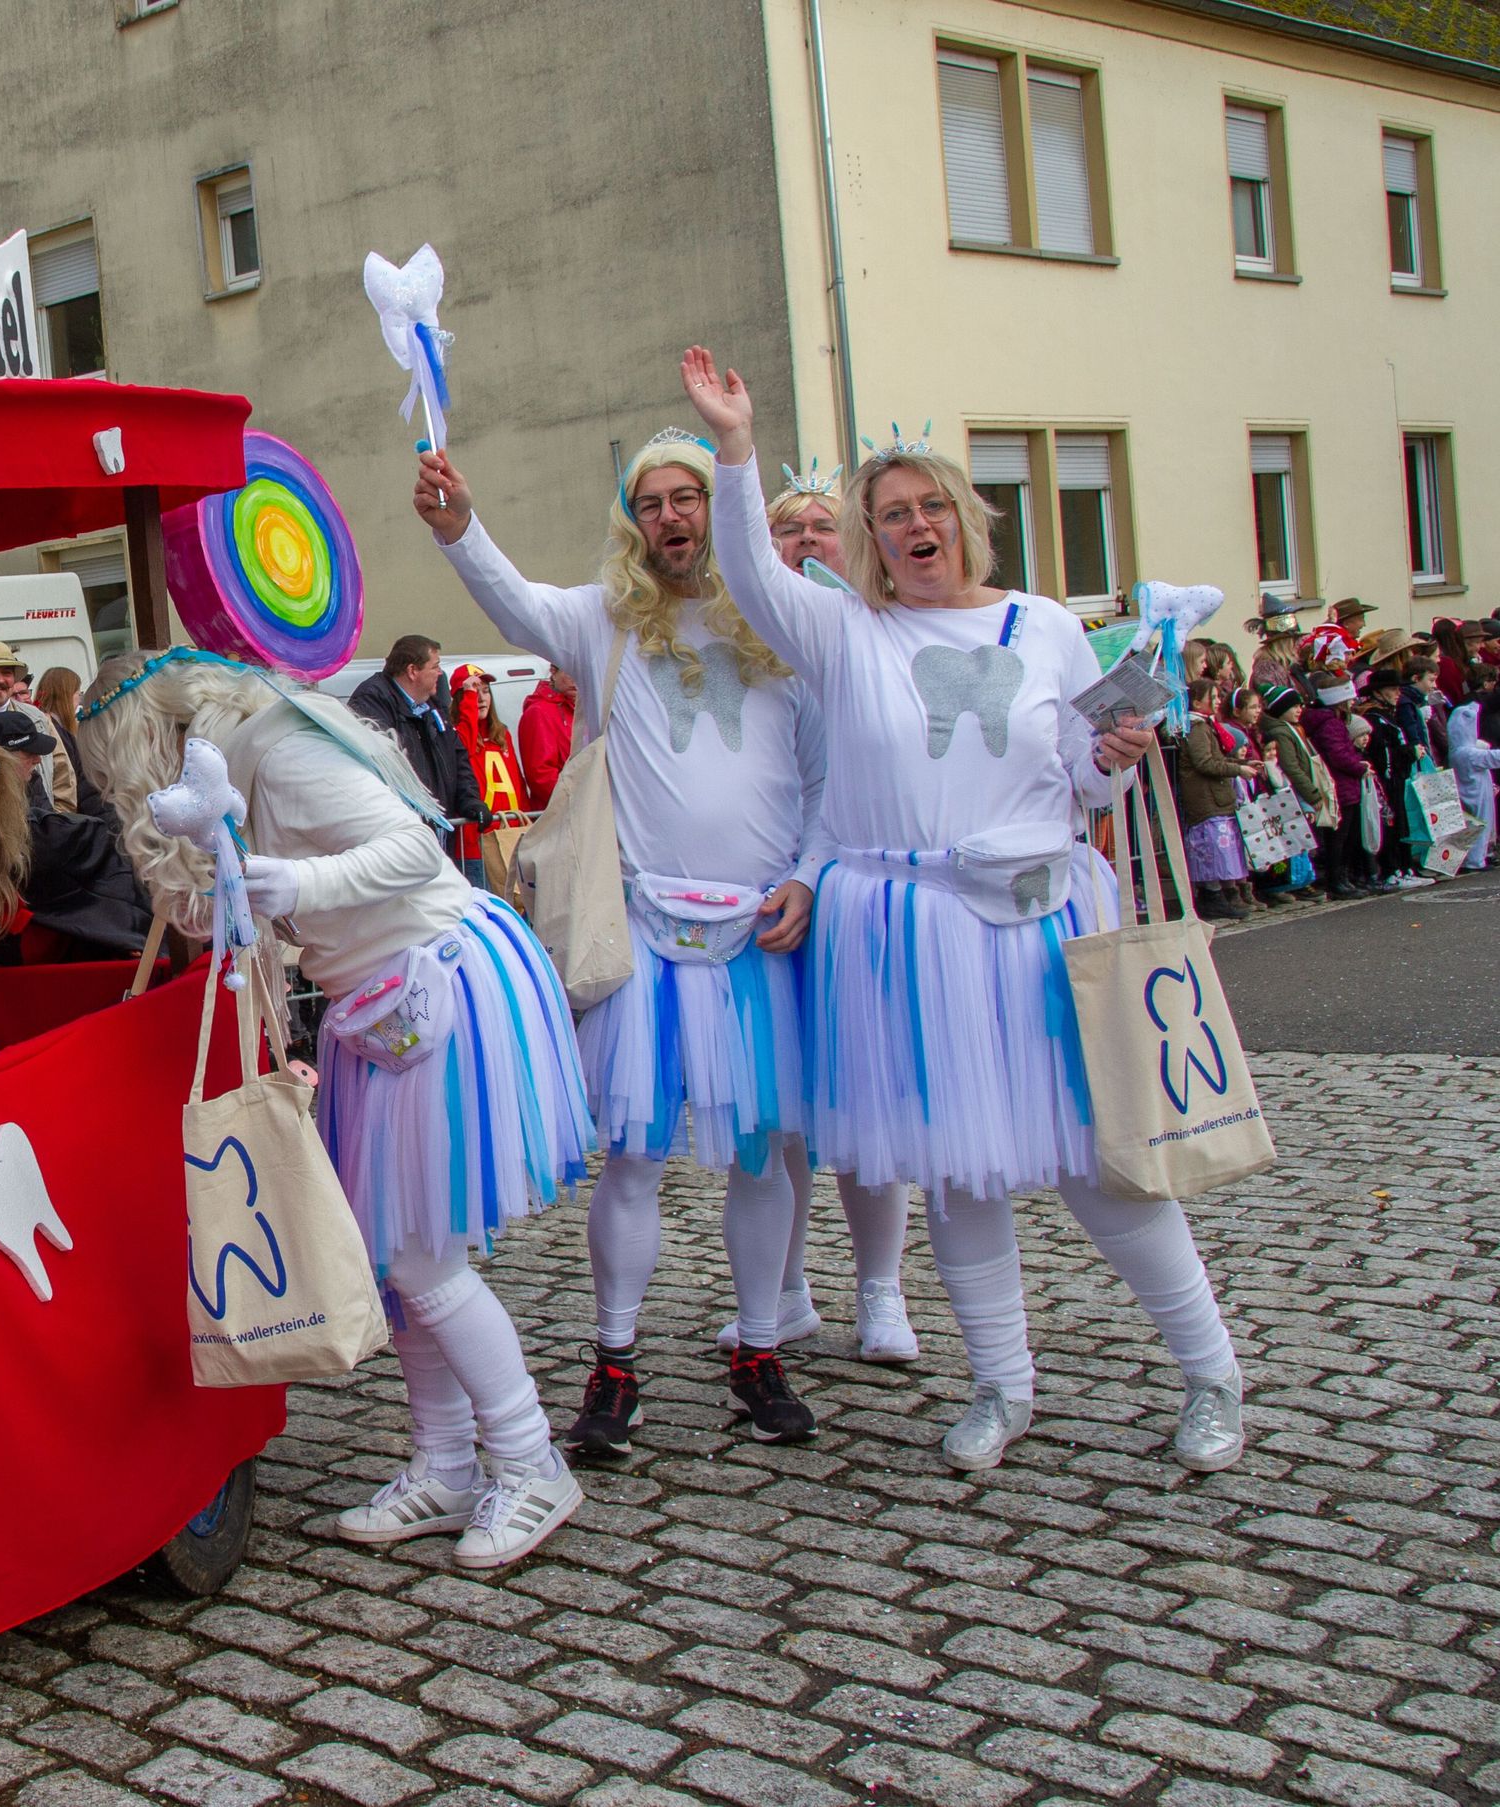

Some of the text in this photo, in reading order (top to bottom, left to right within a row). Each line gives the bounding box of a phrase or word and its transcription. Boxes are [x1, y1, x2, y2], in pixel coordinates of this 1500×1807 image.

[26, 609, 76, 620] FLEURETTE
[484, 751, 519, 812] A
[192, 1311, 327, 1346] aximini-wallerstein.de
